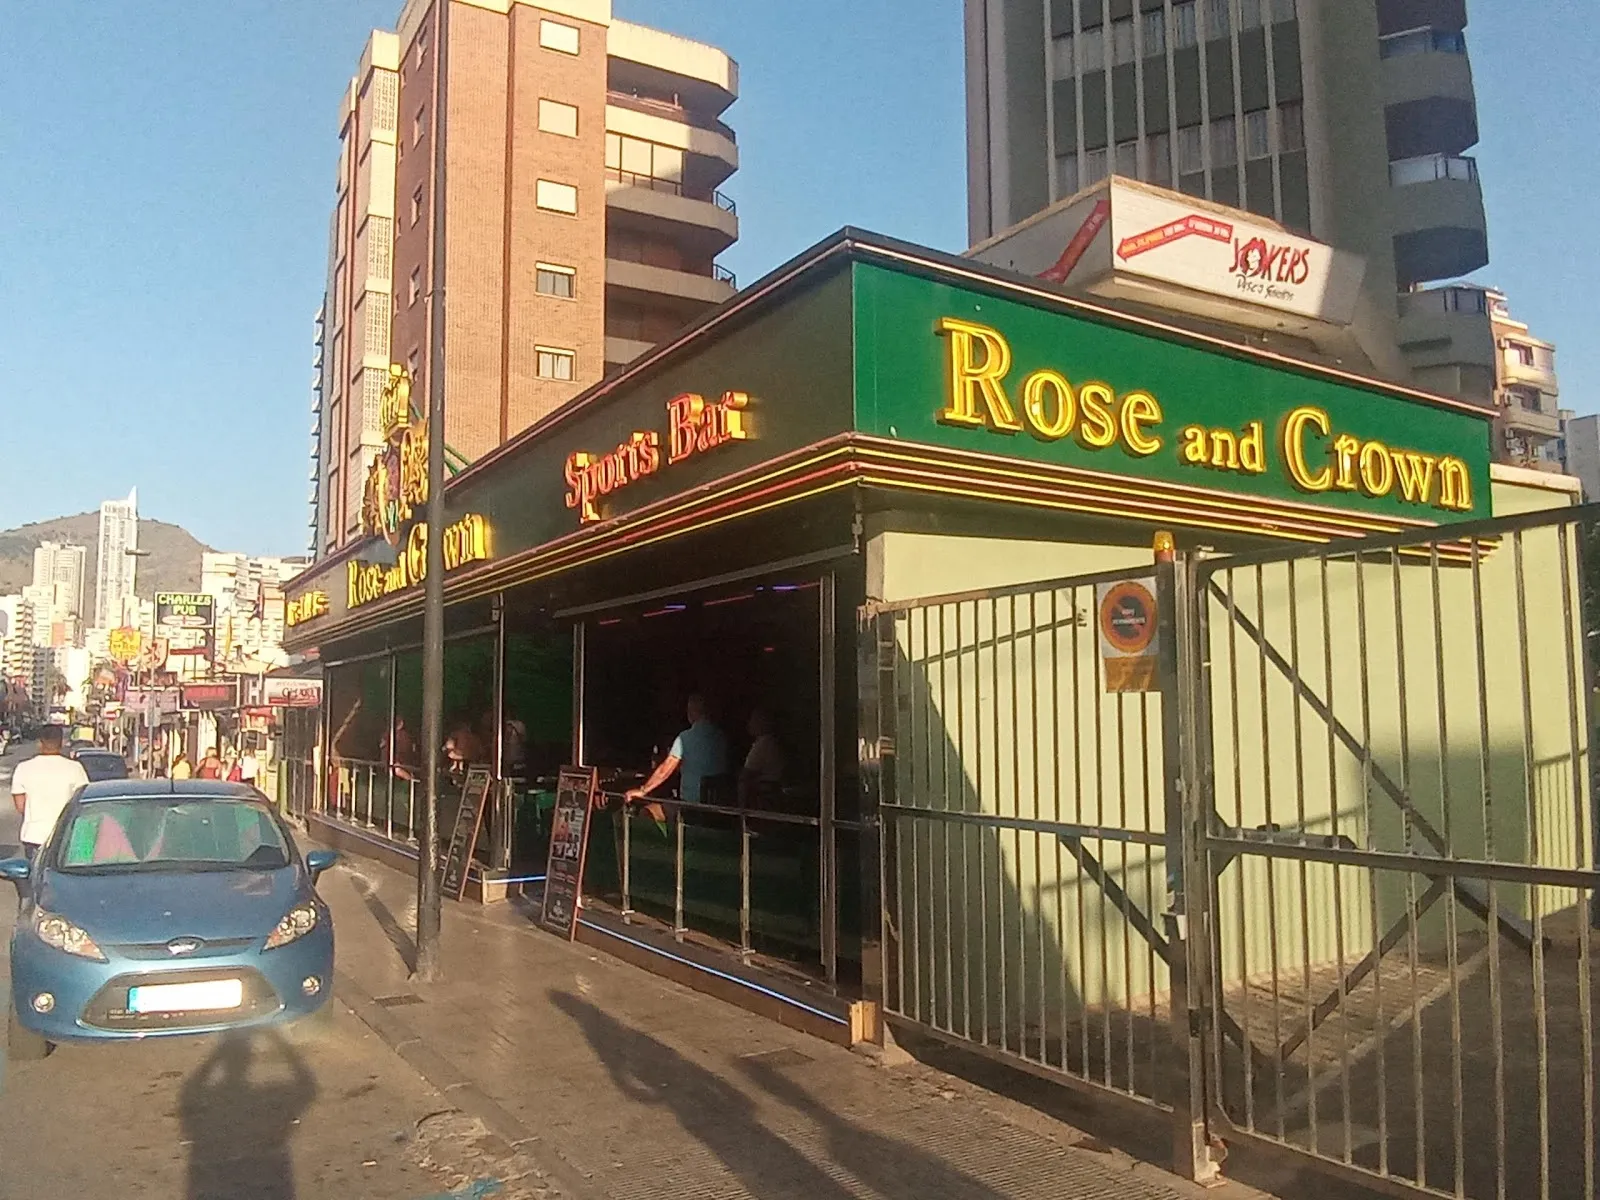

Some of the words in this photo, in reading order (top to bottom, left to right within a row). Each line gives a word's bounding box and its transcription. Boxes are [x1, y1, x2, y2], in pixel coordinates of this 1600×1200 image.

[1229, 237, 1310, 285] JOKERS
[936, 316, 1164, 456] Rose
[1183, 420, 1267, 473] and
[1284, 405, 1474, 512] Crown
[565, 429, 660, 525] Sports
[666, 390, 748, 466] Bar
[346, 559, 383, 610] Rose
[383, 551, 408, 595] and
[407, 512, 487, 588] Crwn
[158, 594, 212, 606] CHARLES
[172, 604, 198, 616] PUB
